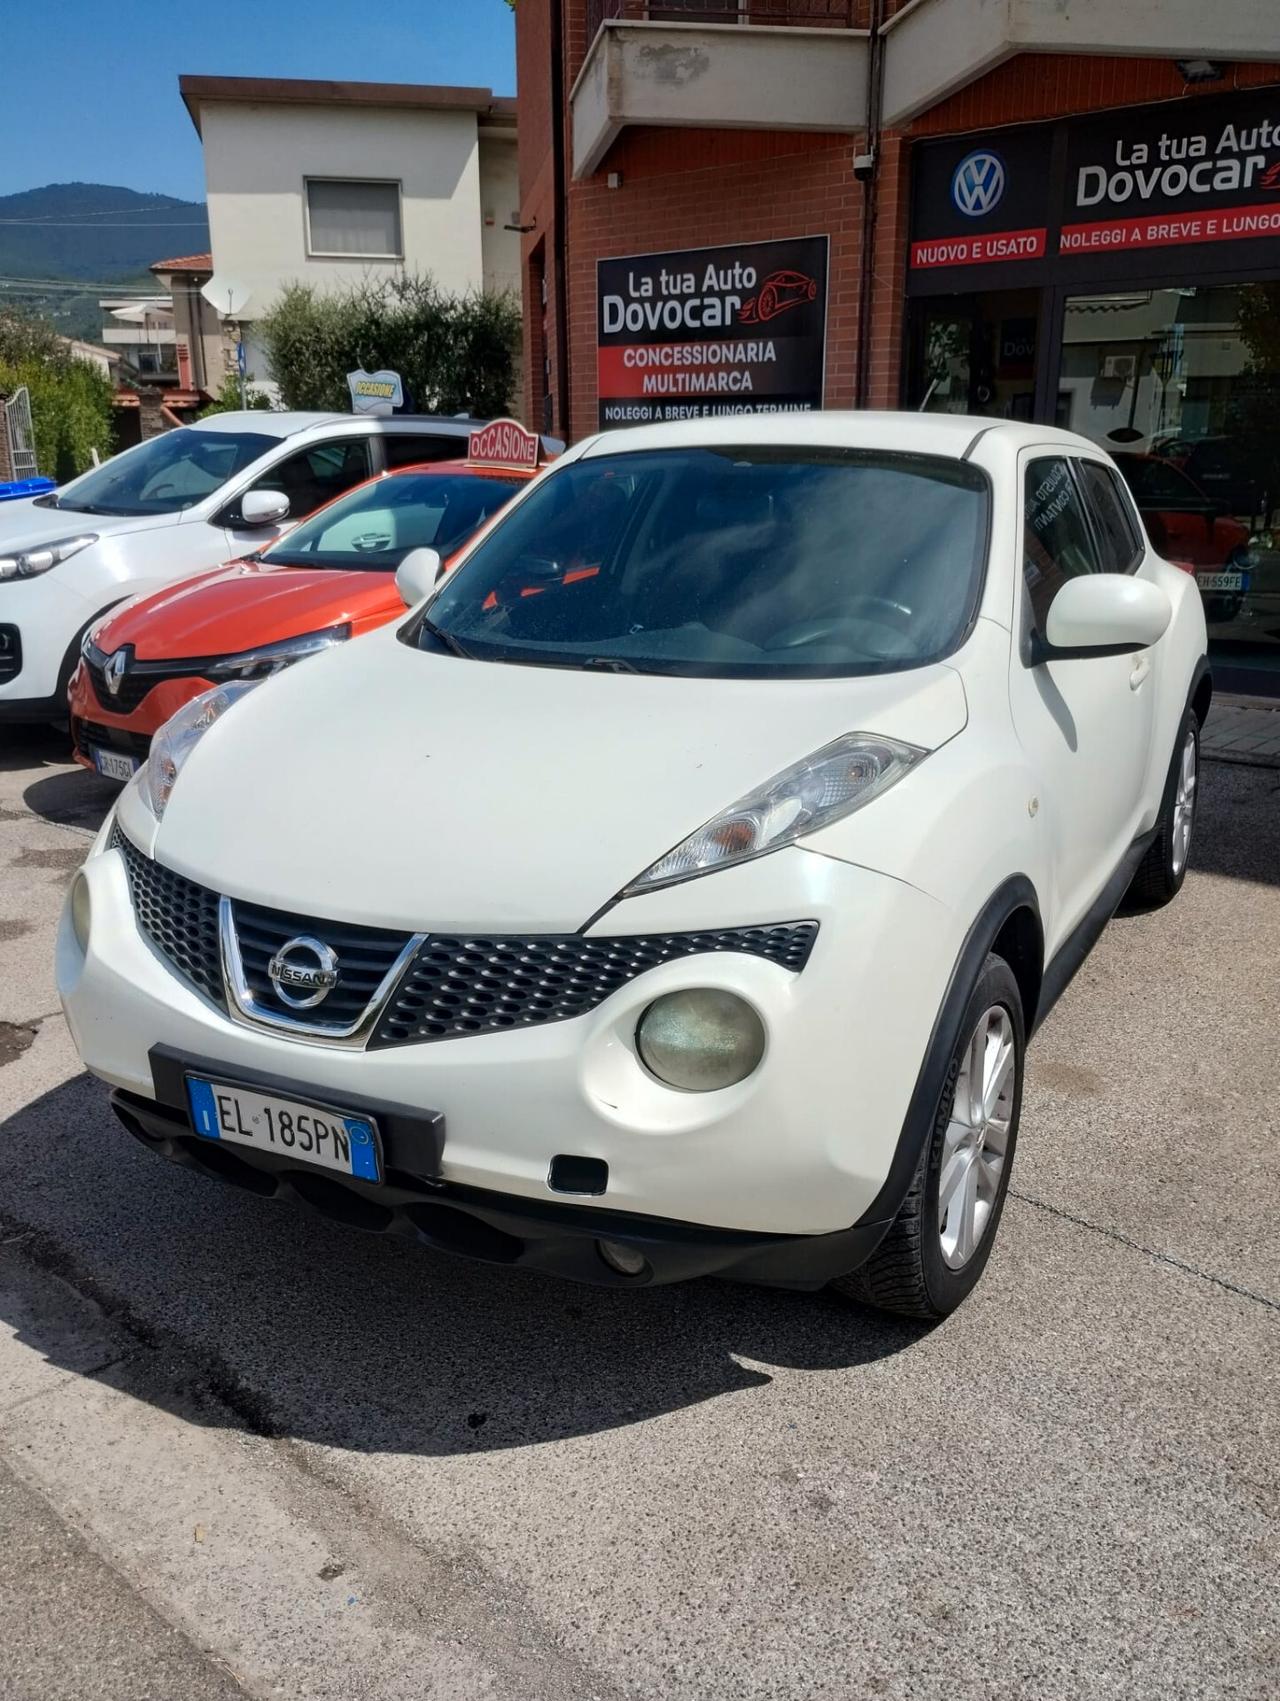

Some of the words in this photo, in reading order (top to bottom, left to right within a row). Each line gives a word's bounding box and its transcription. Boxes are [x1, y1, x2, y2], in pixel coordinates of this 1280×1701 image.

[1115, 139, 1149, 167] La
[1158, 133, 1207, 161] tua
[1076, 155, 1266, 207] Dovocar
[1060, 229, 1127, 249] NOLEGGI
[1130, 228, 1142, 242] A
[1147, 221, 1202, 241] BREVE
[1206, 219, 1218, 235] E
[1222, 213, 1280, 233] LUNGO
[916, 243, 967, 265] NUOVO
[972, 242, 982, 258] E
[986, 236, 1038, 257] USATO
[628, 271, 653, 298] La
[659, 268, 696, 296] tua
[701, 260, 757, 293] Auto
[602, 295, 742, 334] Dovocar
[623, 341, 777, 368] CONCESSIONARIA
[355, 382, 396, 398] OCCASIONE
[642, 370, 753, 393] MULTIMARCA
[605, 406, 652, 420] NOLEGGI
[655, 407, 662, 419] A
[665, 406, 699, 419] BREVE
[703, 405, 709, 417] E
[471, 425, 535, 460] OCCASIONE
[271, 963, 325, 986] NISSAN
[217, 1095, 253, 1137] EL
[264, 1107, 349, 1161] 185PN
[931, 1057, 958, 1168] KUMHO
